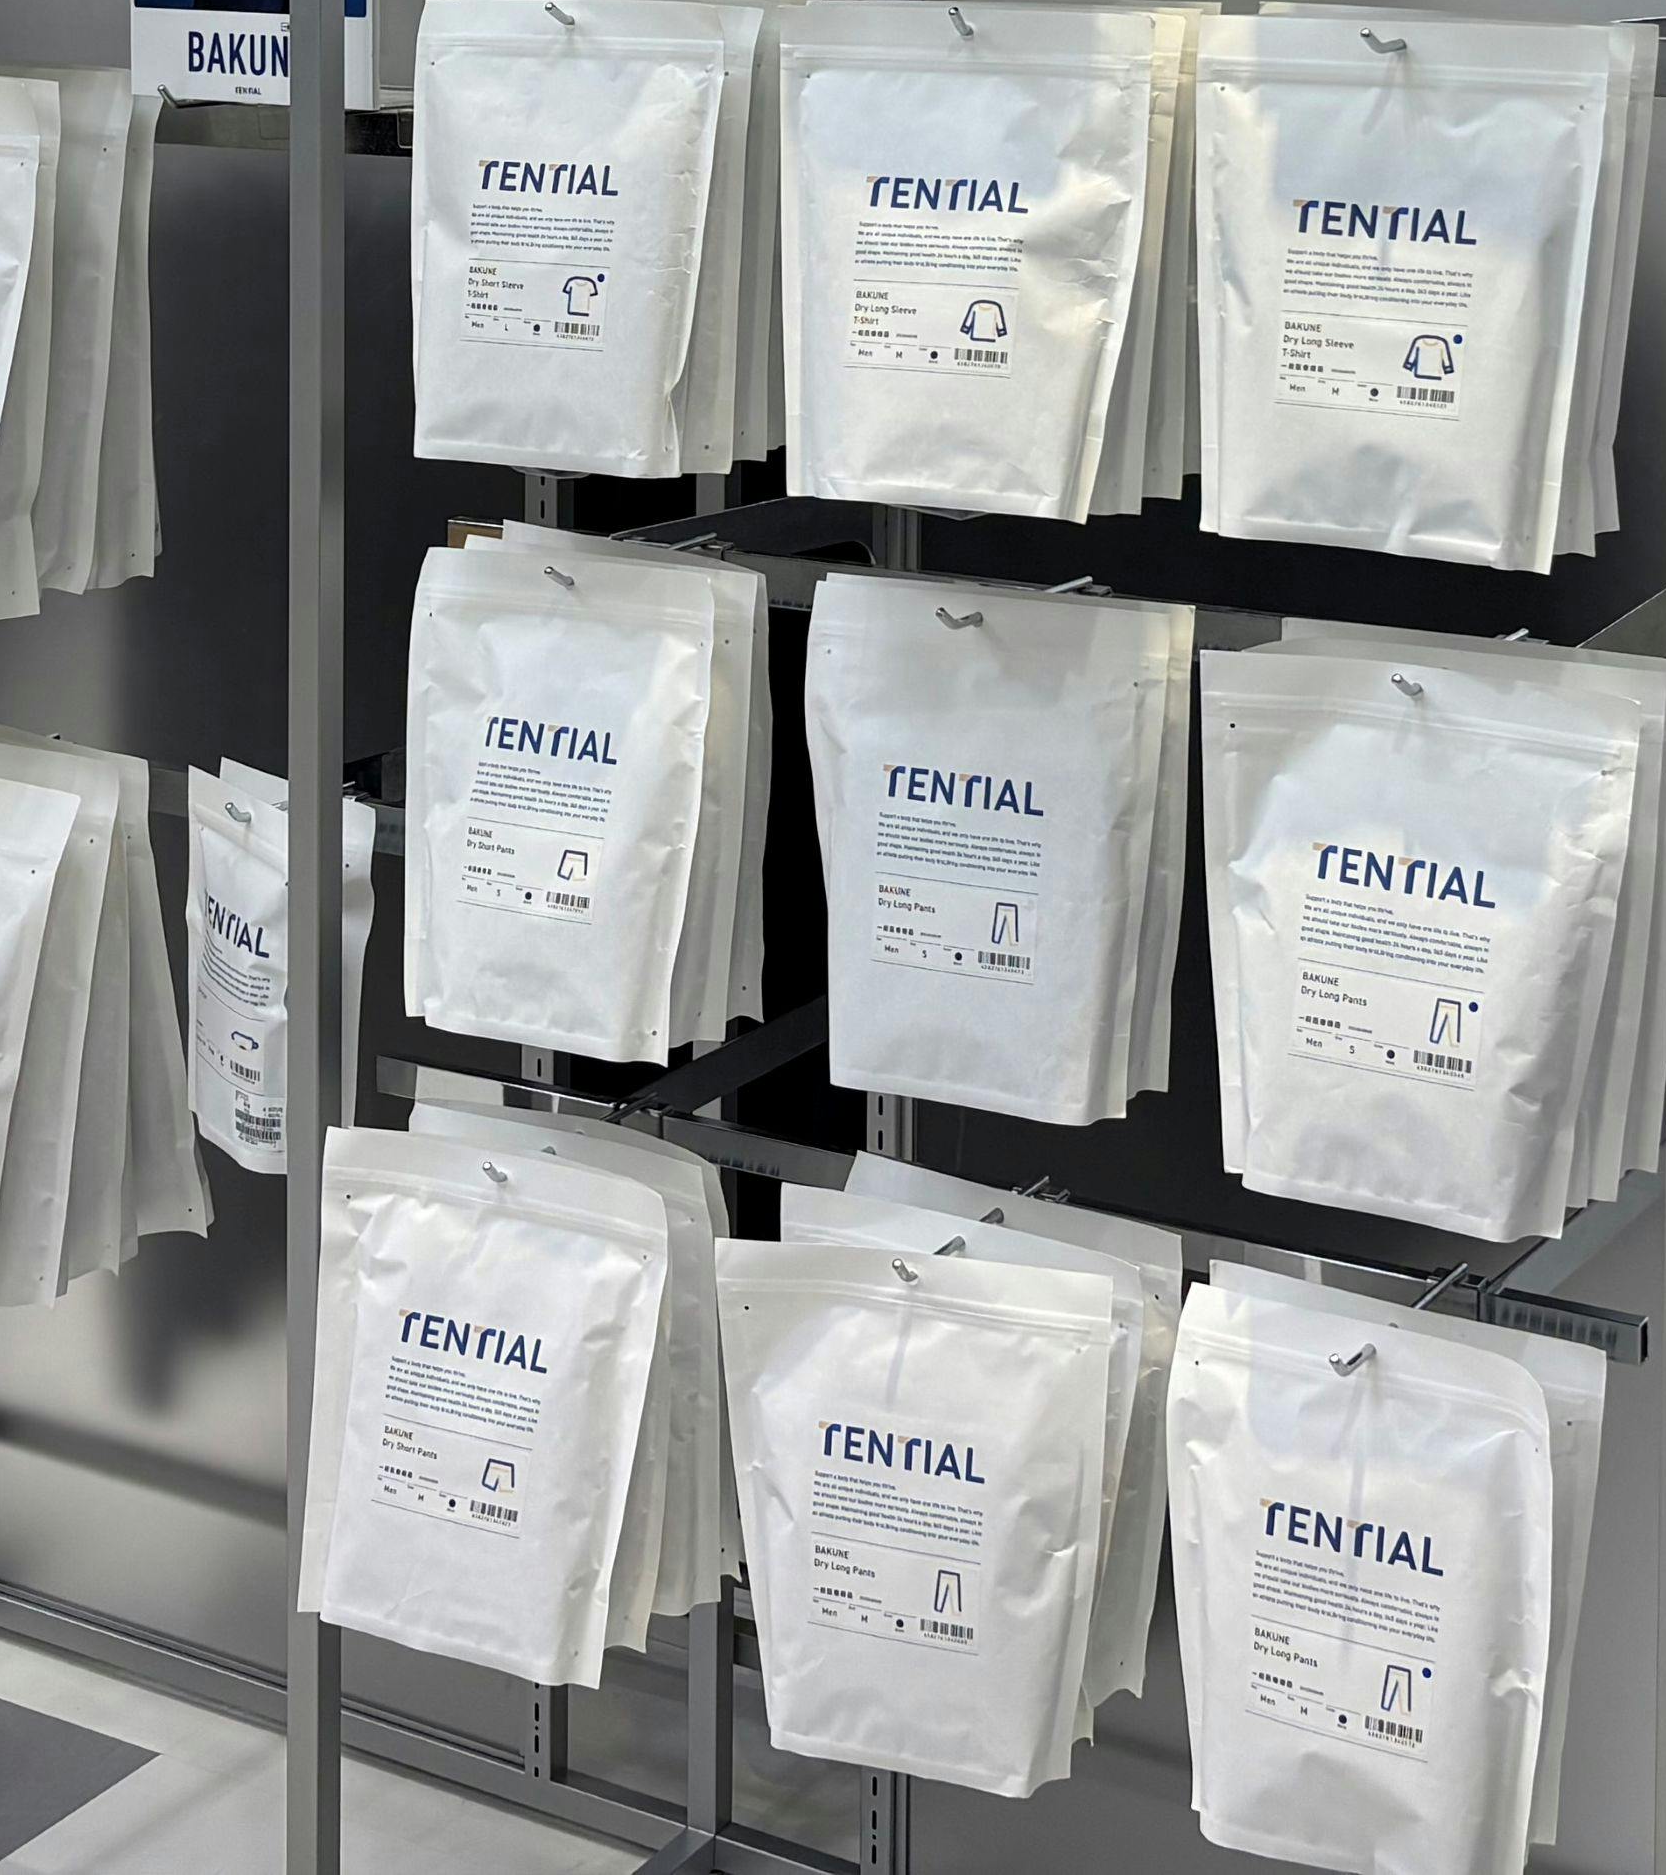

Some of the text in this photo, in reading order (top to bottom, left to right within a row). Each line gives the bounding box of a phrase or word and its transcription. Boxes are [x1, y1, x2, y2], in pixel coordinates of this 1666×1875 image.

[188, 31, 289, 78] BAKUN
[479, 160, 619, 197] TENTIAL
[866, 176, 1029, 214] TENTIAL
[1293, 199, 1477, 246] TENTIAL
[856, 290, 889, 301] BAKUNE
[855, 303, 868, 315] Dry
[1285, 322, 1322, 333] BAKUNE
[1283, 334, 1355, 350] Dry Long Sleeve
[1282, 348, 1311, 360] T-Shirt
[485, 716, 617, 765] TENTIAL
[883, 764, 1044, 817] TENTIAL
[1312, 842, 1496, 909] TENTIAL
[878, 884, 911, 897] BAKUNE
[878, 897, 892, 910] Dry
[1302, 972, 1340, 987] BAKUNE
[1301, 985, 1368, 1007] Dry Long Pants
[399, 1308, 548, 1374] TENTIAL
[819, 1421, 985, 1484] TENTIAL
[1260, 1498, 1444, 1577] TENTIAL
[815, 1545, 850, 1560] BAKUNE
[814, 1558, 876, 1578] Dry Long Pants
[1254, 1627, 1290, 1645] BAKUNE
[1253, 1642, 1318, 1667] Dry Long Pants
